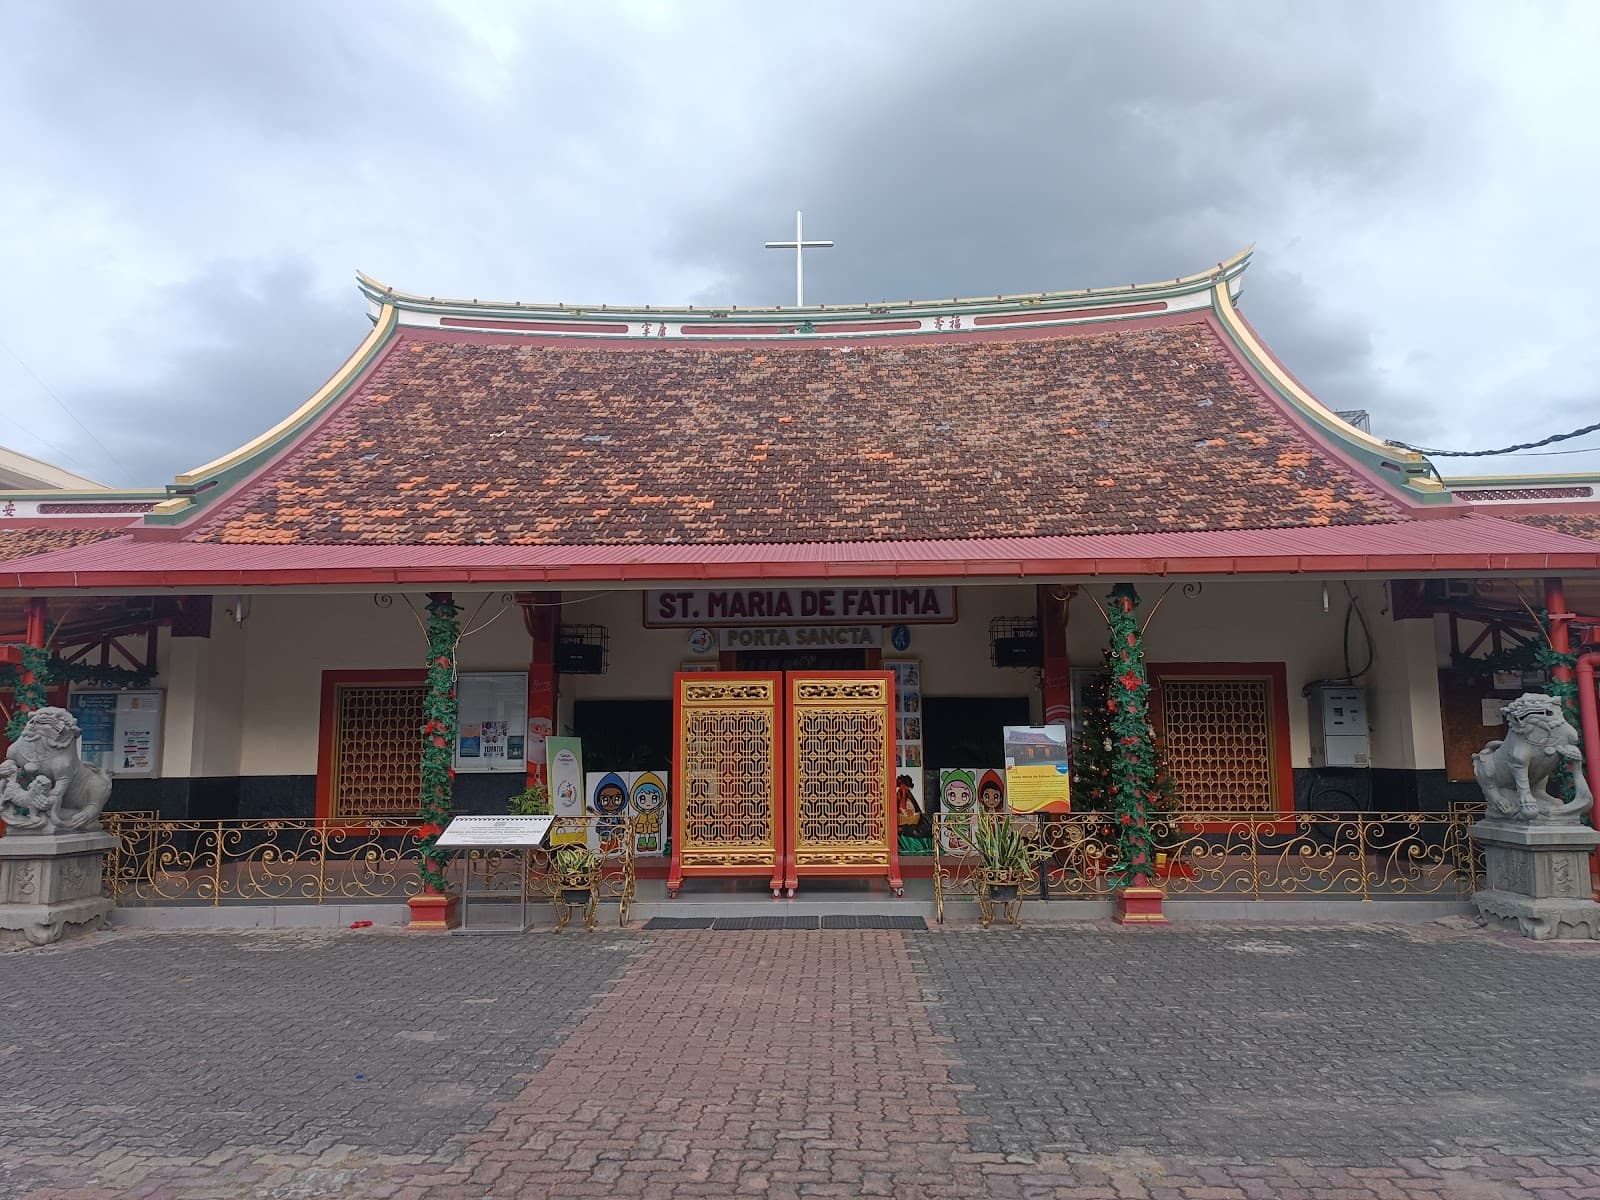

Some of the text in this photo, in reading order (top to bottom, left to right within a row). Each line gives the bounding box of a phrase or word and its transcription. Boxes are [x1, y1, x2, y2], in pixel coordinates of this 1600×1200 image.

[659, 588, 940, 618] ST. MARIA DE FATIMA
[727, 628, 790, 647] PORTA
[796, 627, 873, 646] SANCTA
